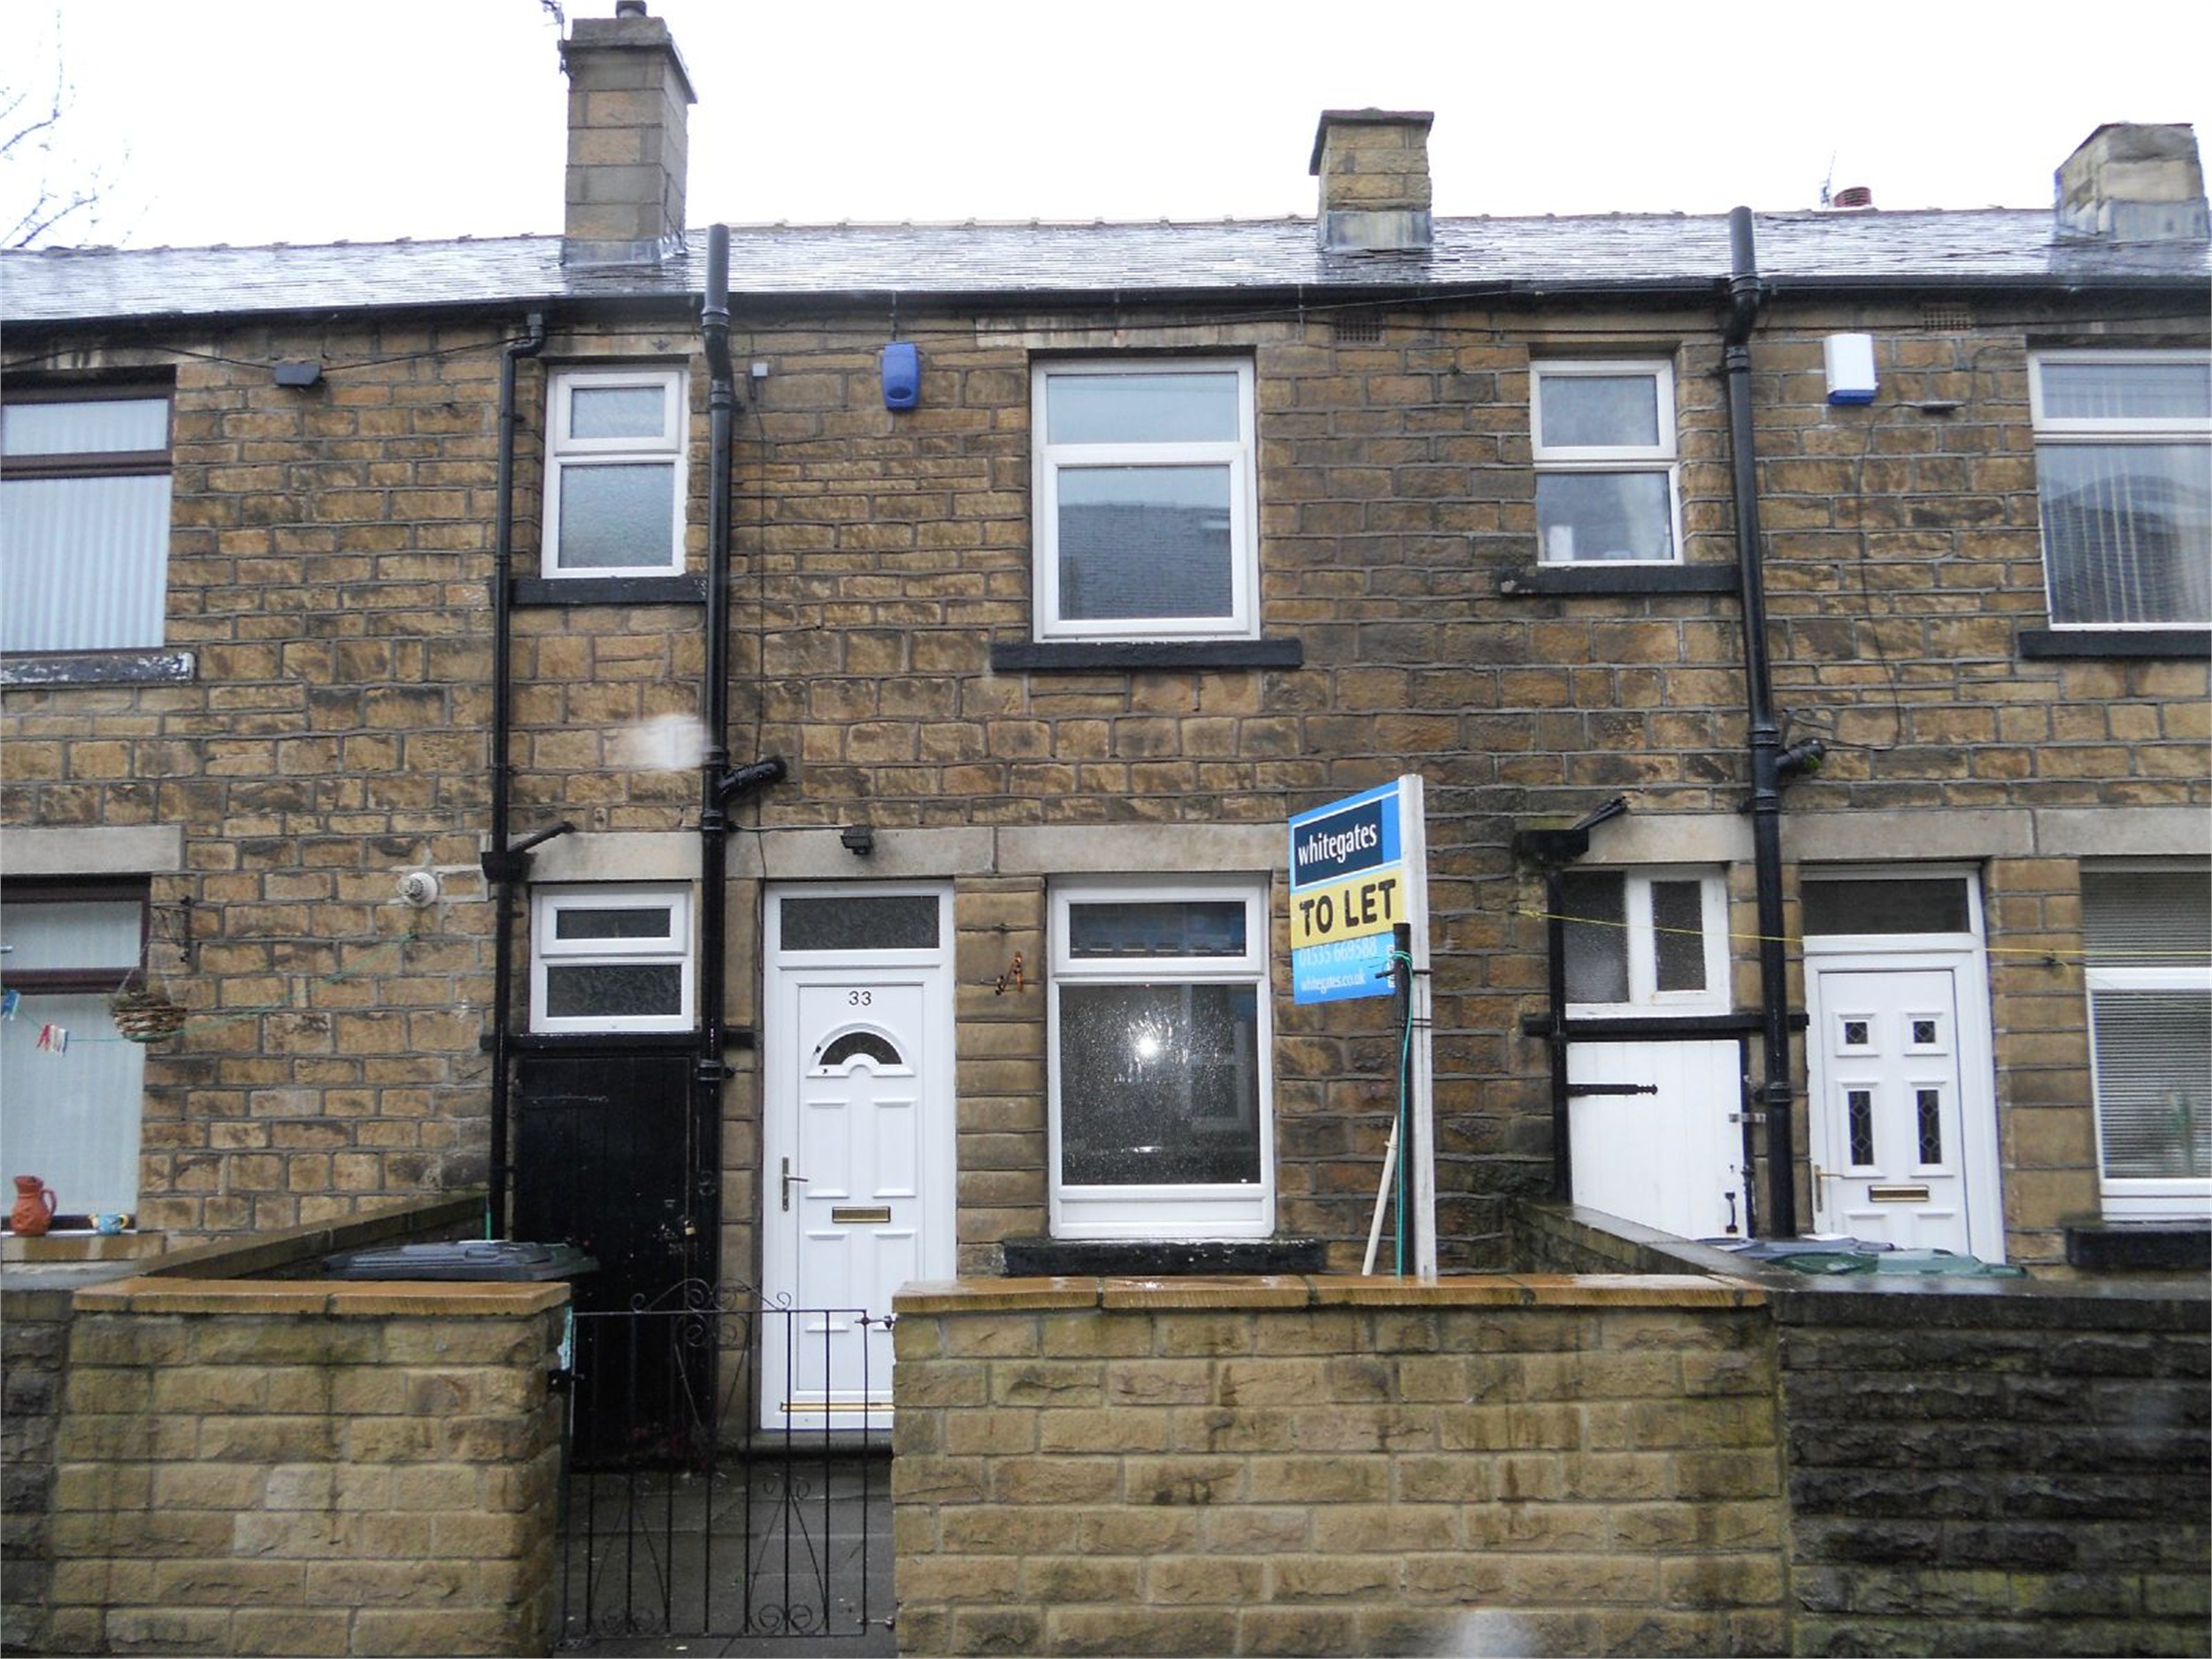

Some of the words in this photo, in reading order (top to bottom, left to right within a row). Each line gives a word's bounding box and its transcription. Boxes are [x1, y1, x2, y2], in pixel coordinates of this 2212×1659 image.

[1298, 823, 1377, 866] whitegates
[1299, 895, 1333, 936] TO
[1344, 879, 1396, 927] LET
[1299, 943, 1331, 966] 01535
[849, 990, 872, 1006] 33
